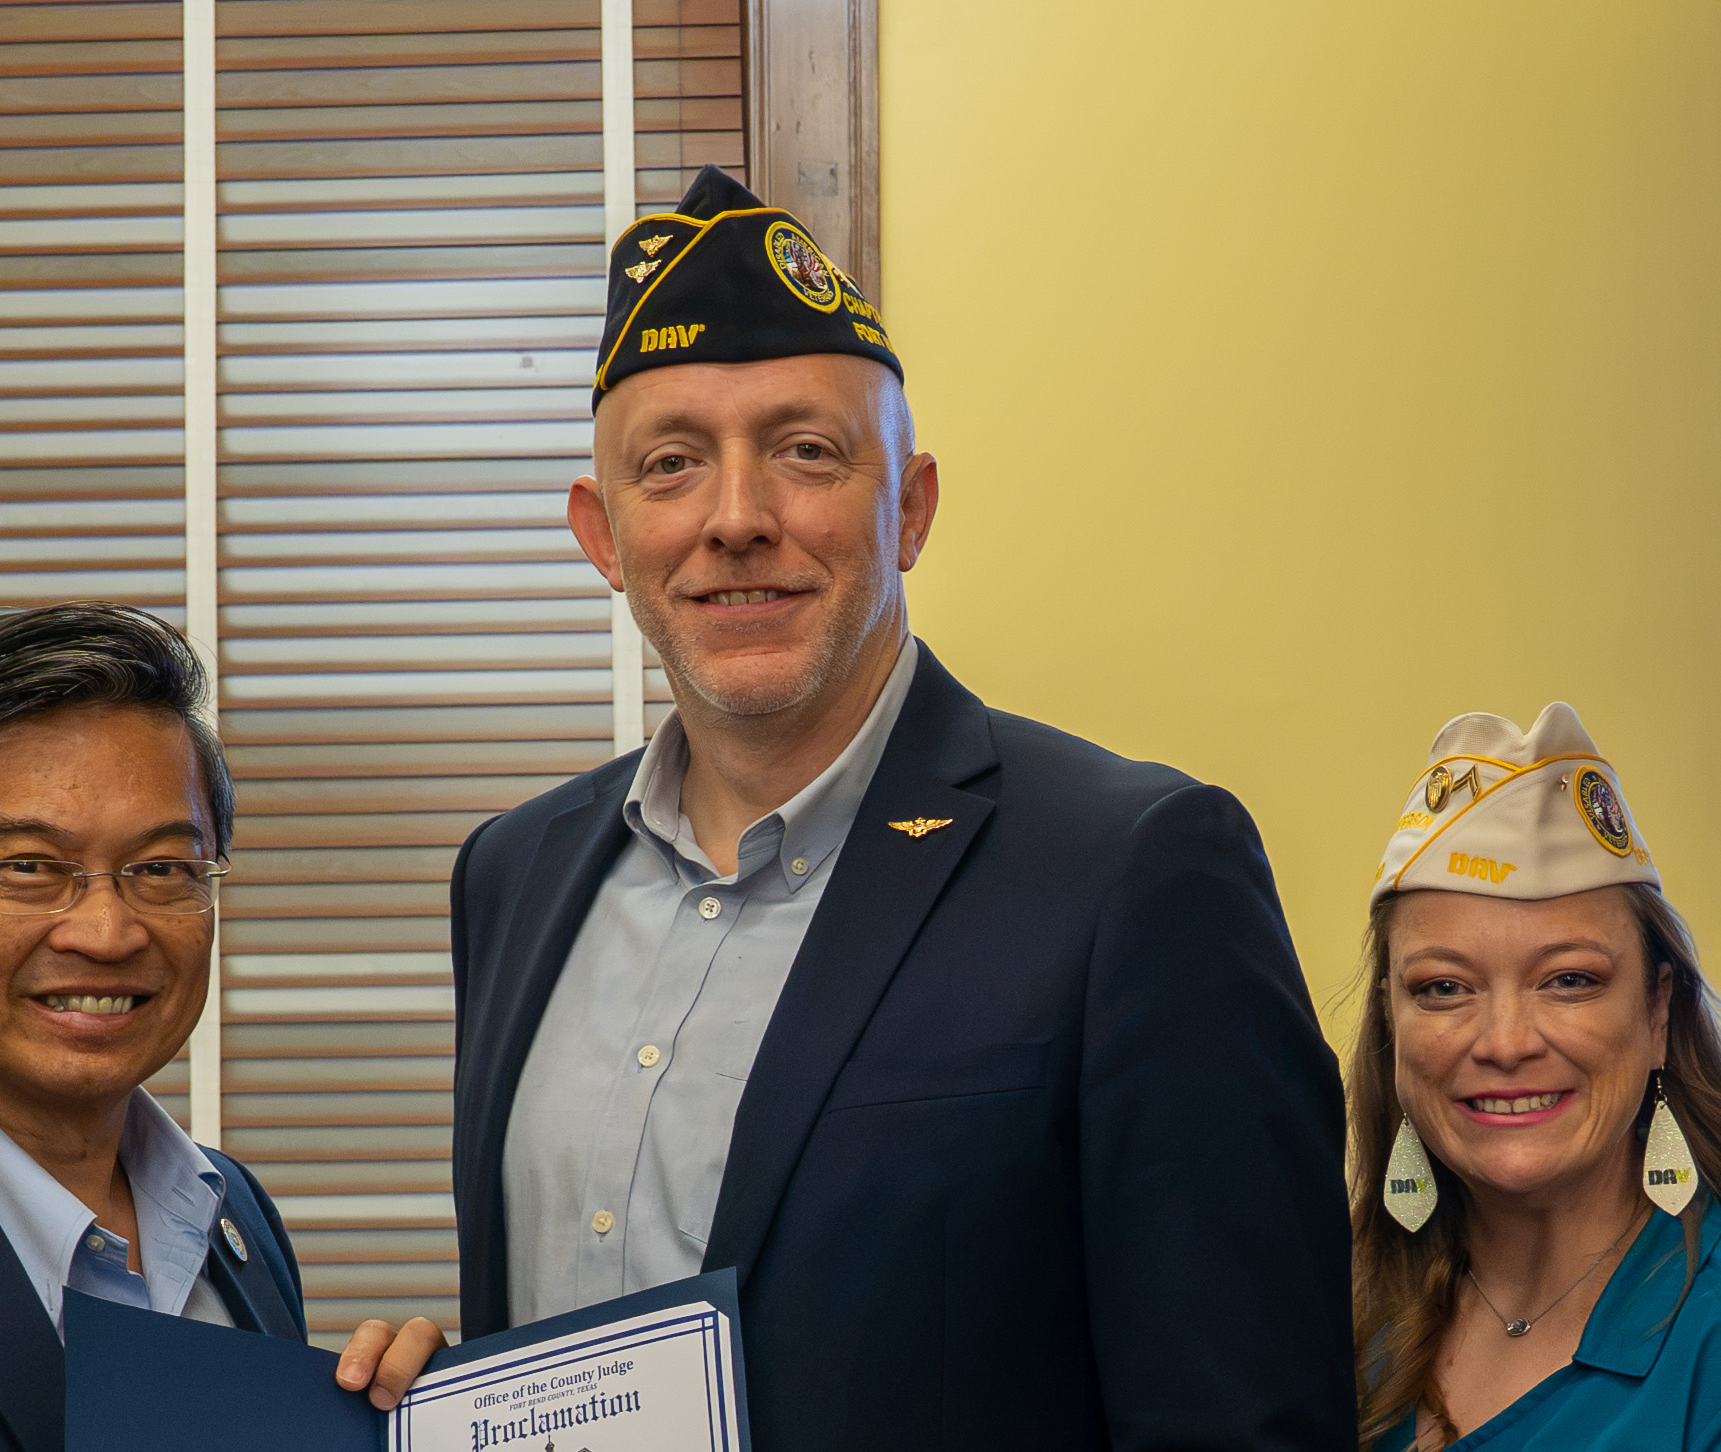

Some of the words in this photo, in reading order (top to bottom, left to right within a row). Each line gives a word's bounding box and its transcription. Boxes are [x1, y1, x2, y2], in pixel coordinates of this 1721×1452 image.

[1447, 852, 1517, 884] DAV
[1390, 1178, 1430, 1194] DAV
[1648, 1169, 1690, 1186] DAV
[474, 1393, 509, 1410] Office
[512, 1384, 526, 1400] of
[527, 1382, 547, 1396] the
[550, 1370, 595, 1390] County
[597, 1360, 634, 1380] Judge
[509, 1400, 527, 1411] FORT
[527, 1396, 547, 1407] BEND
[576, 1382, 598, 1394] TEXAS
